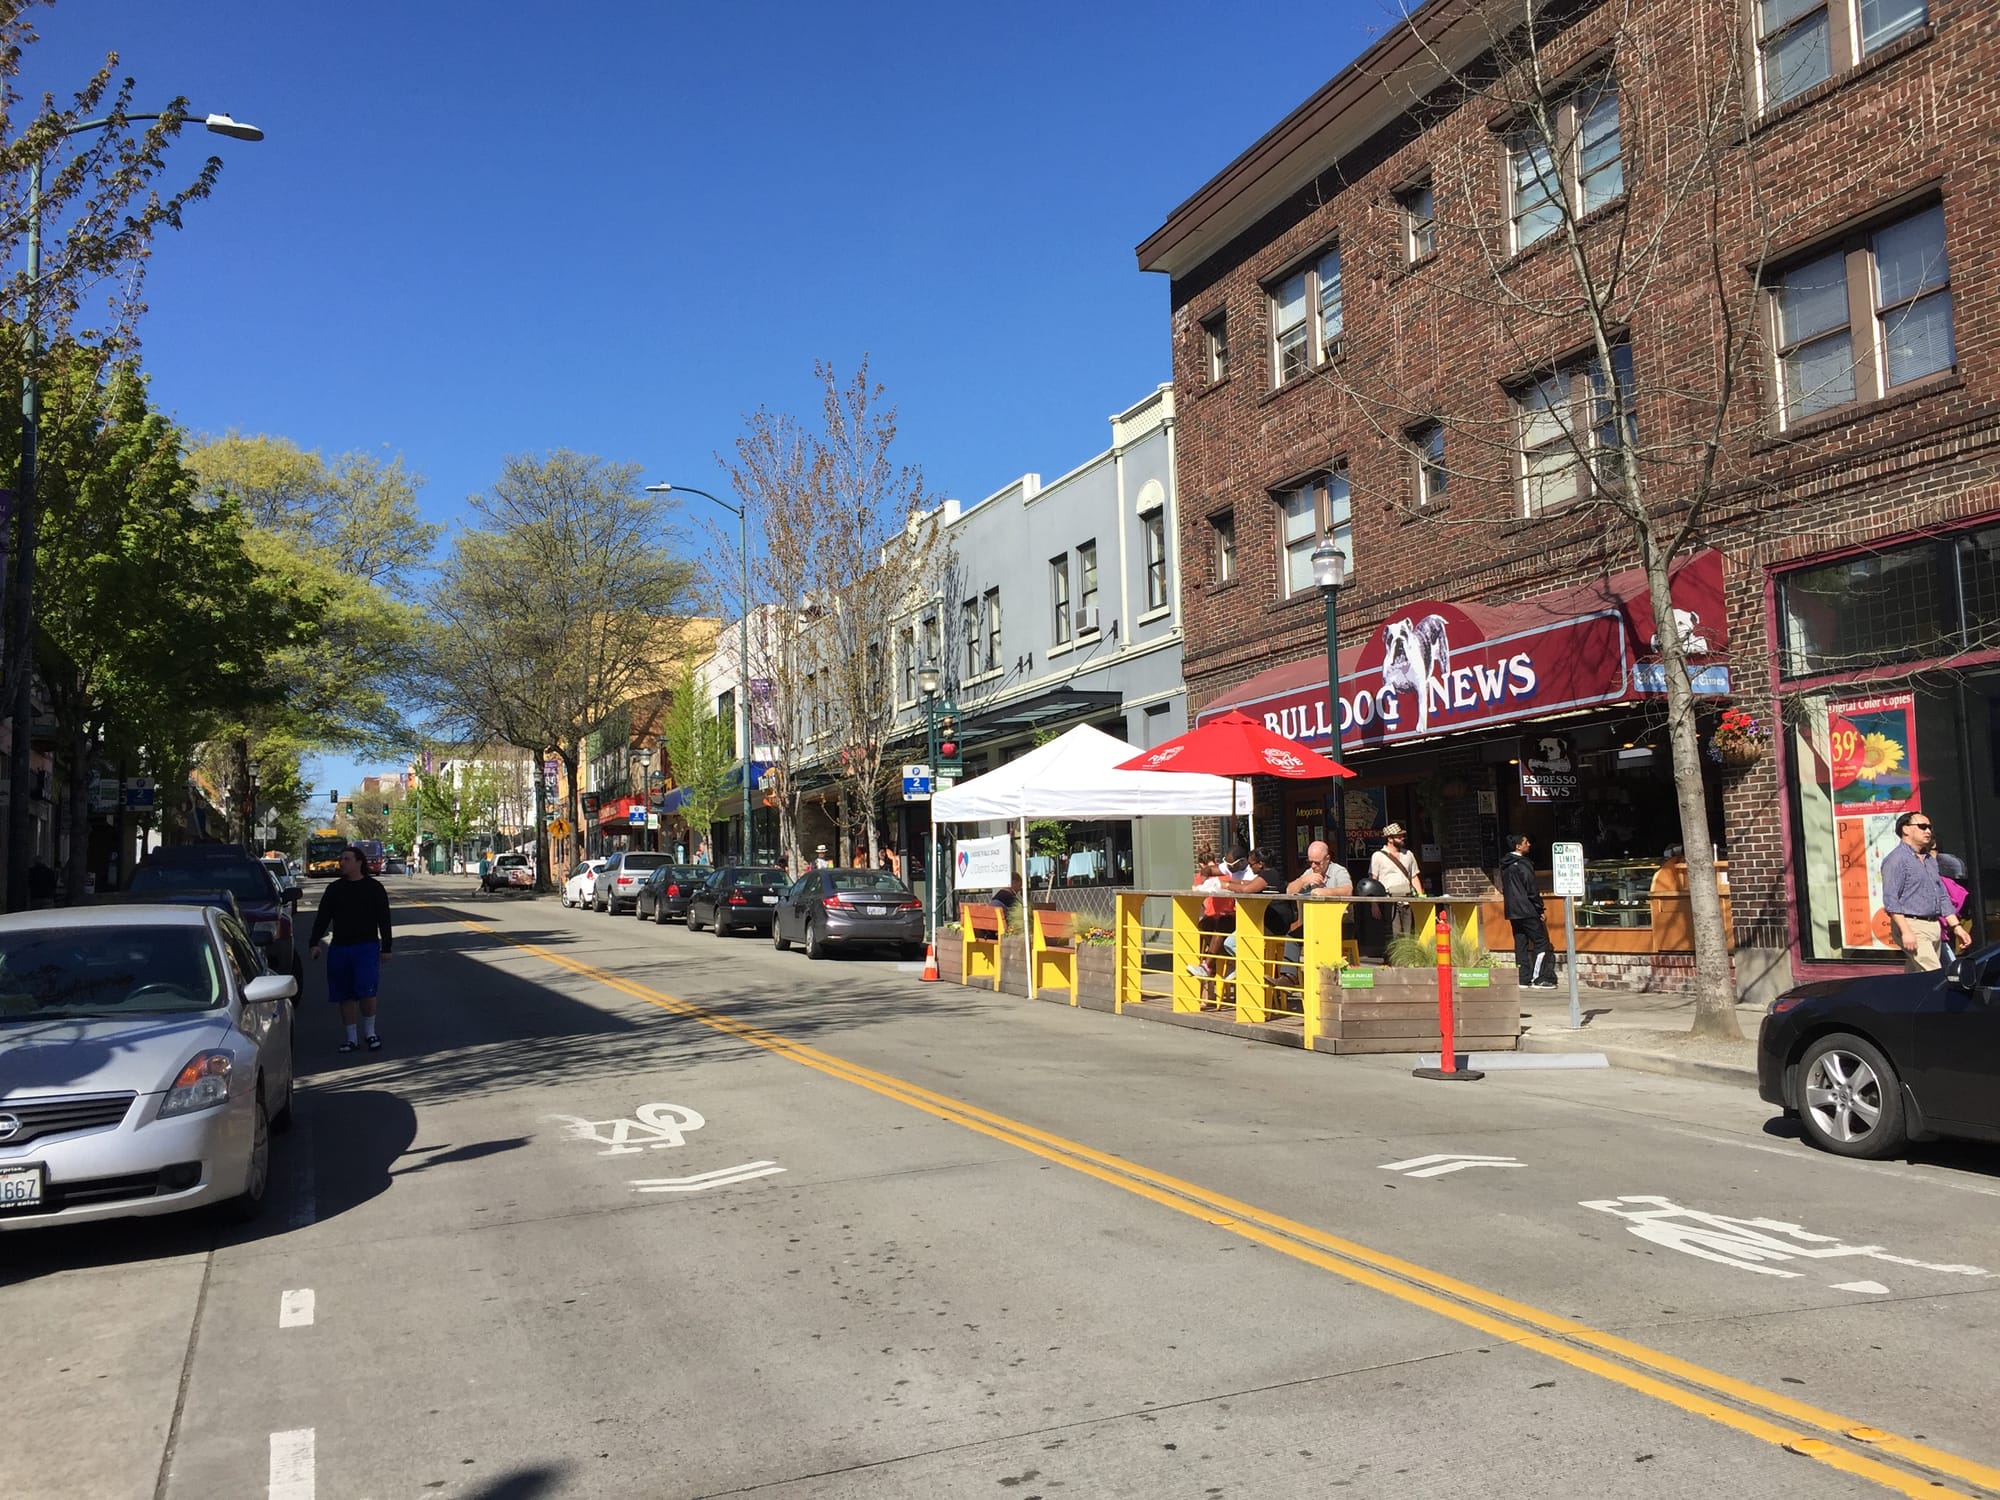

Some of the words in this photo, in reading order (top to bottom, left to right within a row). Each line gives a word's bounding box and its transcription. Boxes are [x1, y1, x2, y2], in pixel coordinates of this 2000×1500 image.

[1263, 684, 1400, 740] BULLDOG
[1428, 652, 1537, 713] NEWS
[1828, 701, 1857, 713] Digital
[1858, 697, 1881, 710] Color
[1882, 694, 1912, 708] Copies
[913, 778, 921, 787] 2
[1523, 775, 1577, 785] ESPRESSO
[1531, 787, 1570, 797] NEWS
